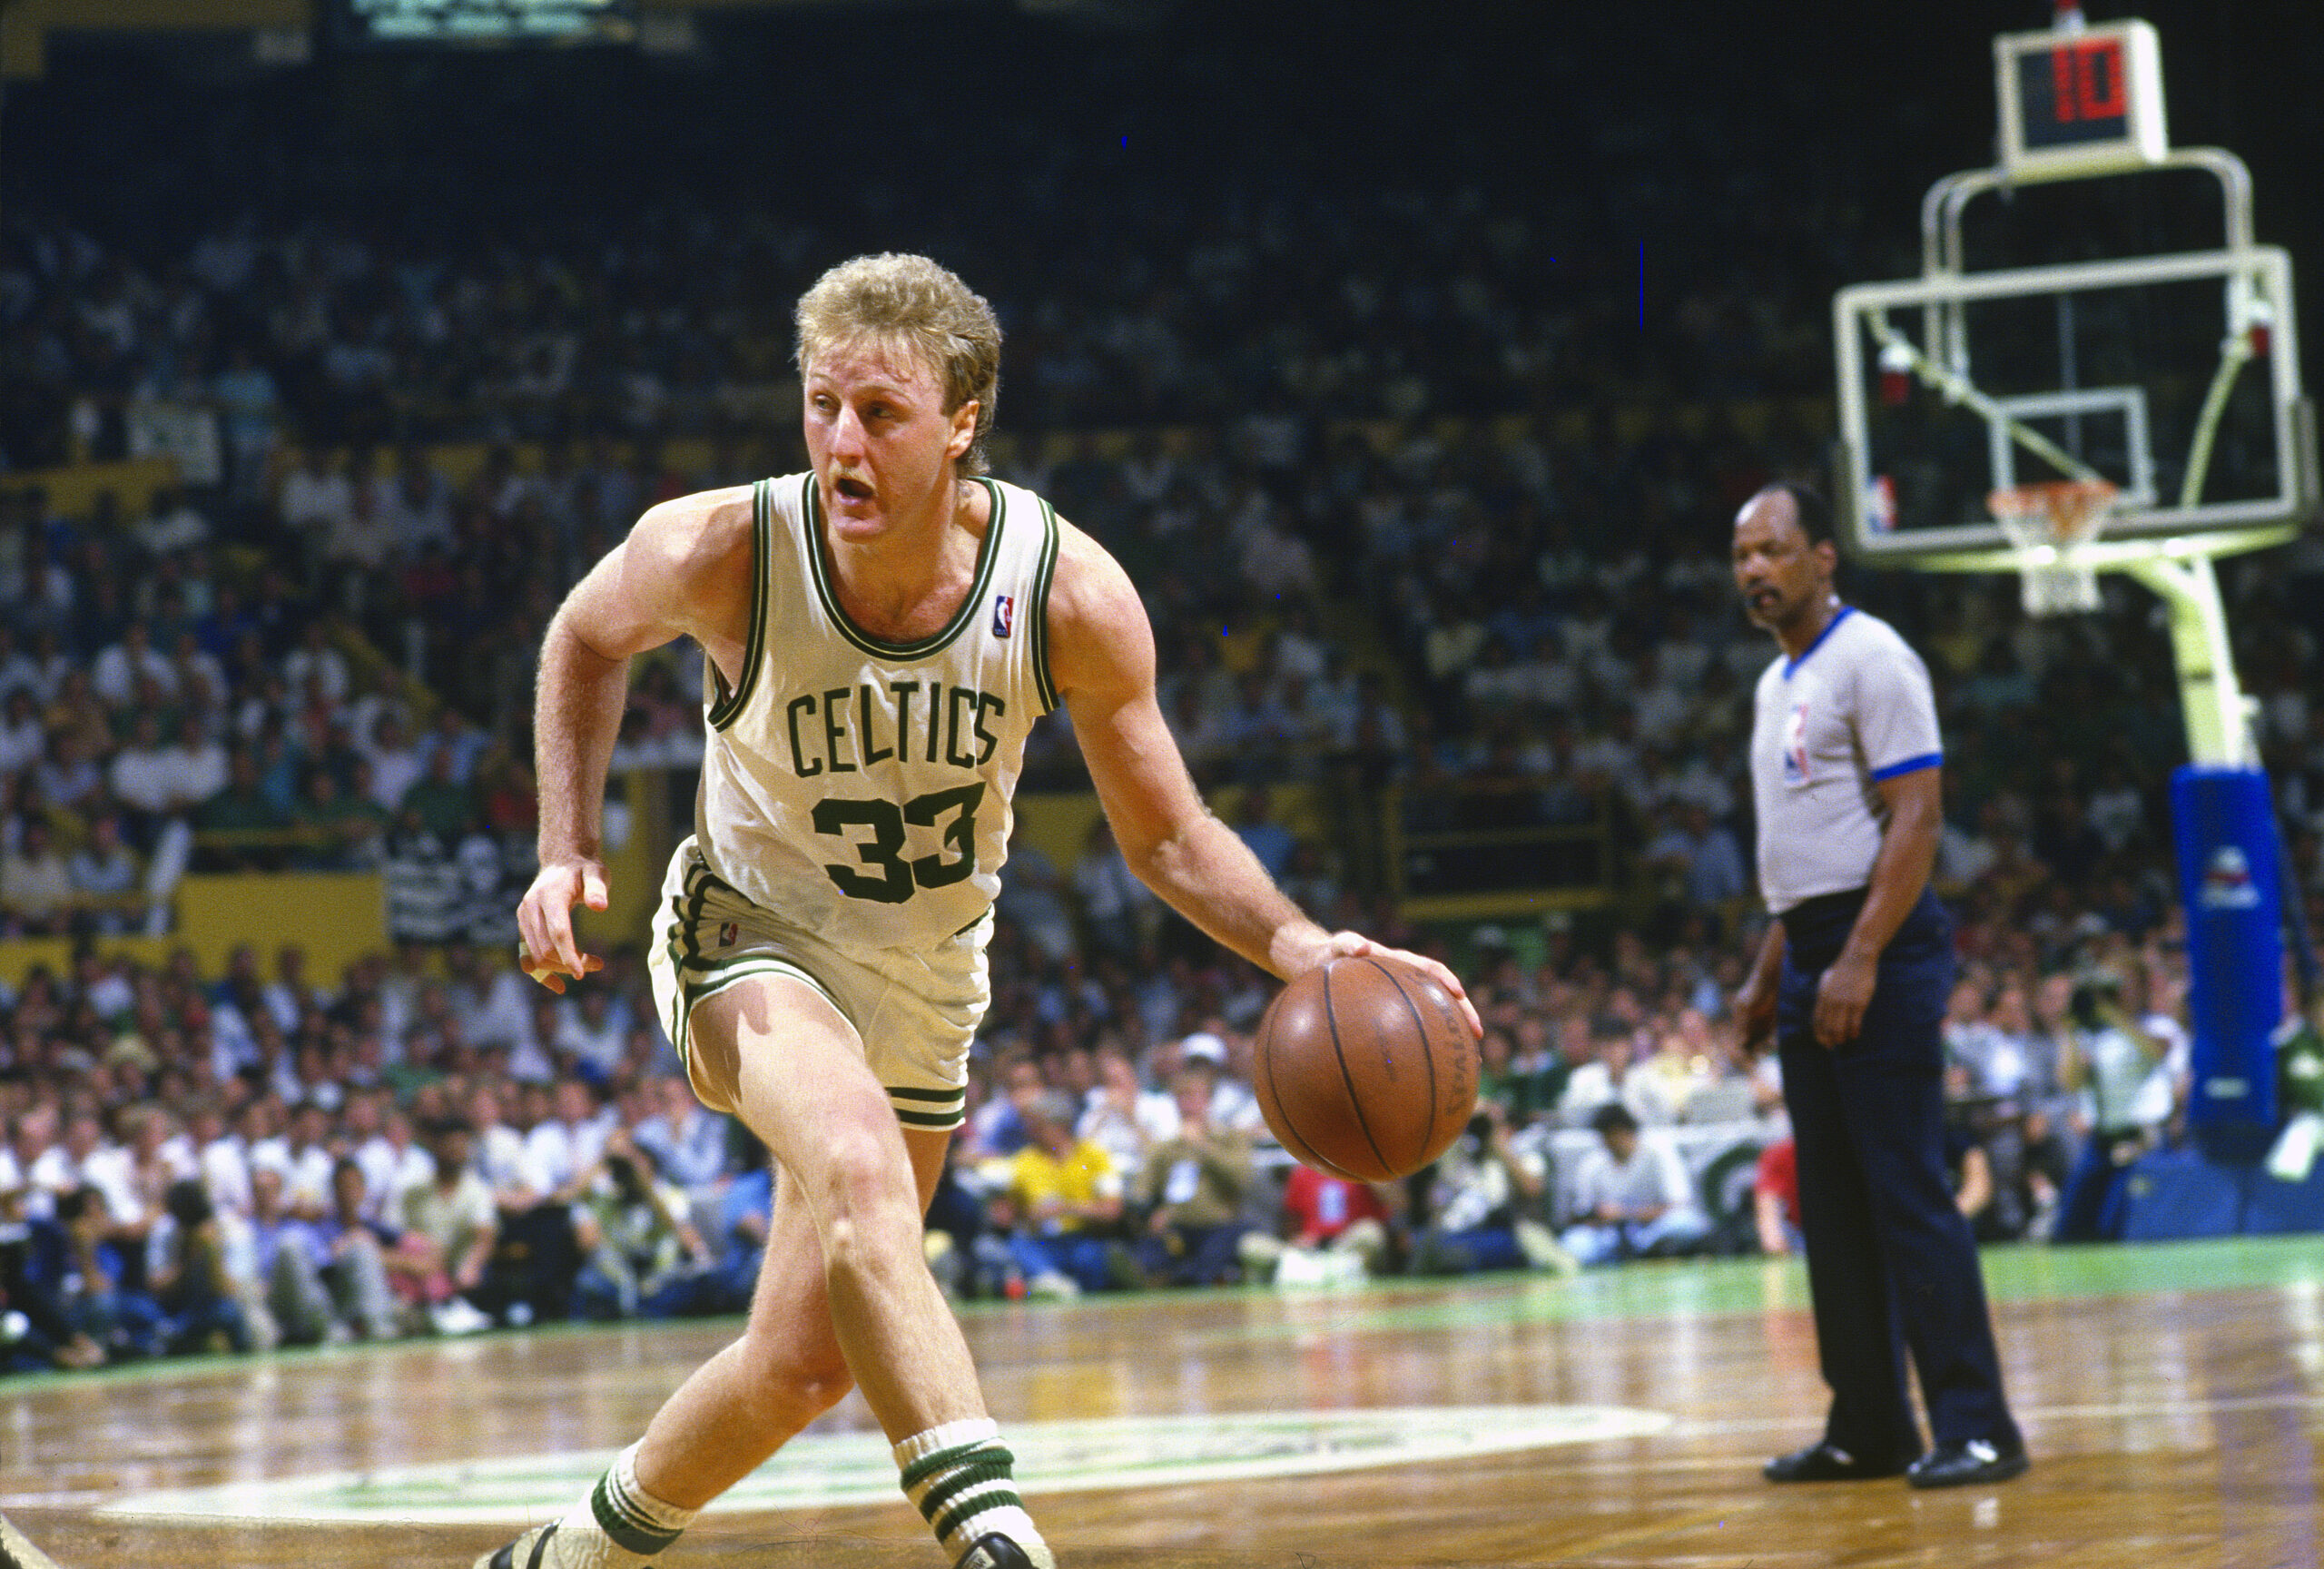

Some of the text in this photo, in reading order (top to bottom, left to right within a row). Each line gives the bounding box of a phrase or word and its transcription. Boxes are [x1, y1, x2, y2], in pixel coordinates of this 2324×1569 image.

[2053, 40, 2125, 122] 10
[788, 682, 1006, 778] CELTICS
[811, 781, 986, 904] 33
